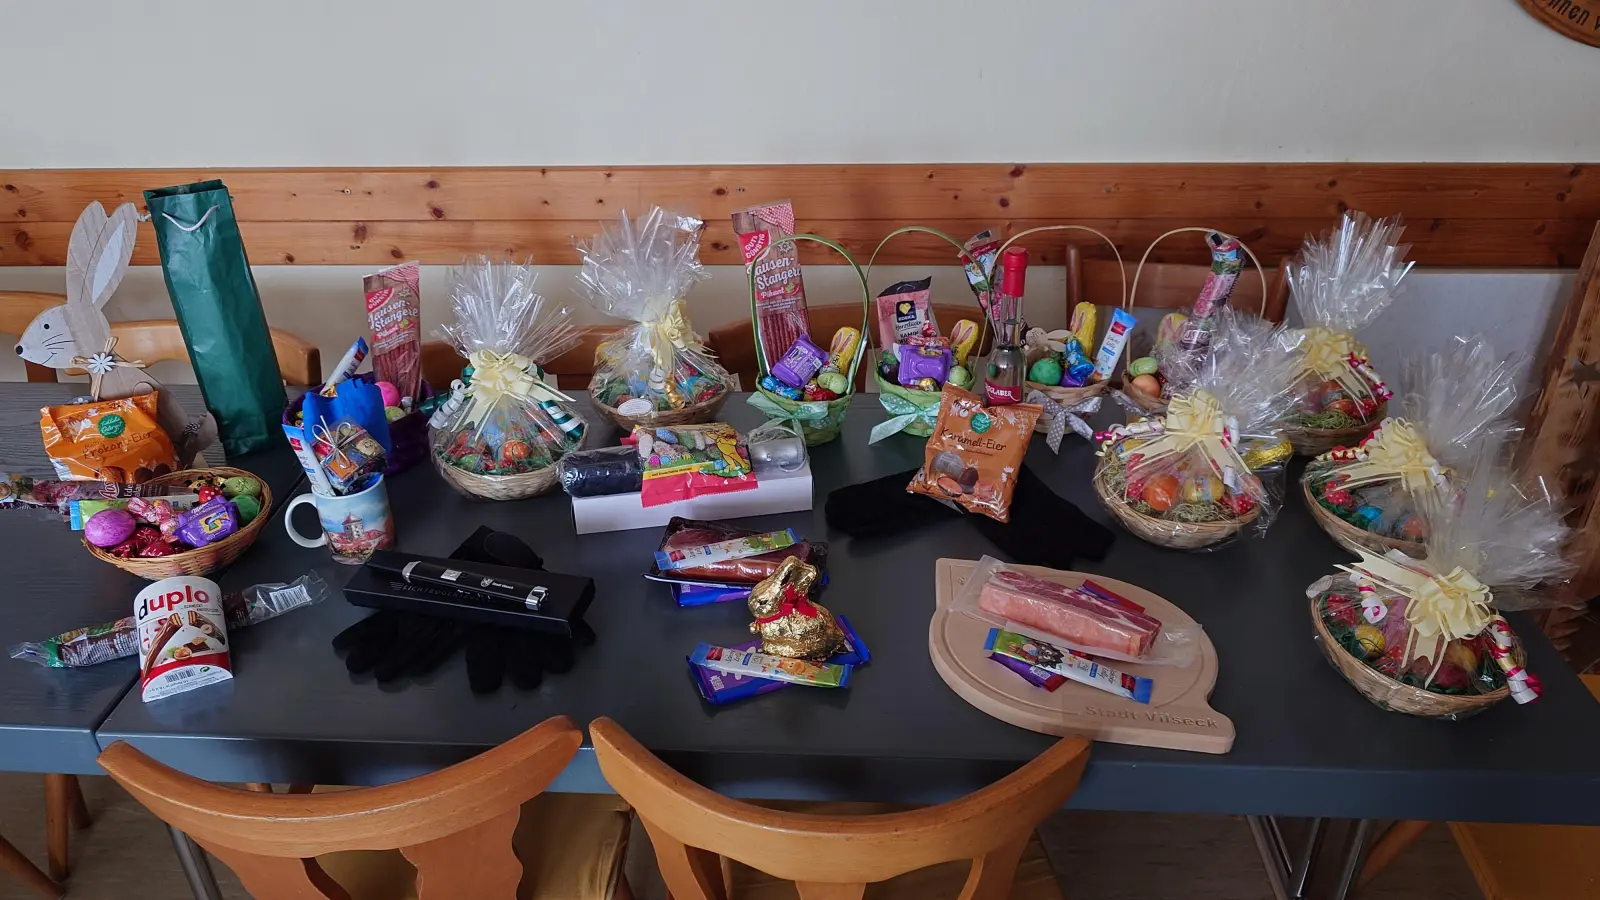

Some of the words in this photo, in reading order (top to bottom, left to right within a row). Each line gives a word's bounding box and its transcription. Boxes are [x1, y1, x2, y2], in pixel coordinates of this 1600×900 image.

[99, 481, 120, 499] Aos
[139, 585, 210, 620] duplo
[1085, 706, 1139, 720] Stadt
[1144, 711, 1219, 728] Vilseck
